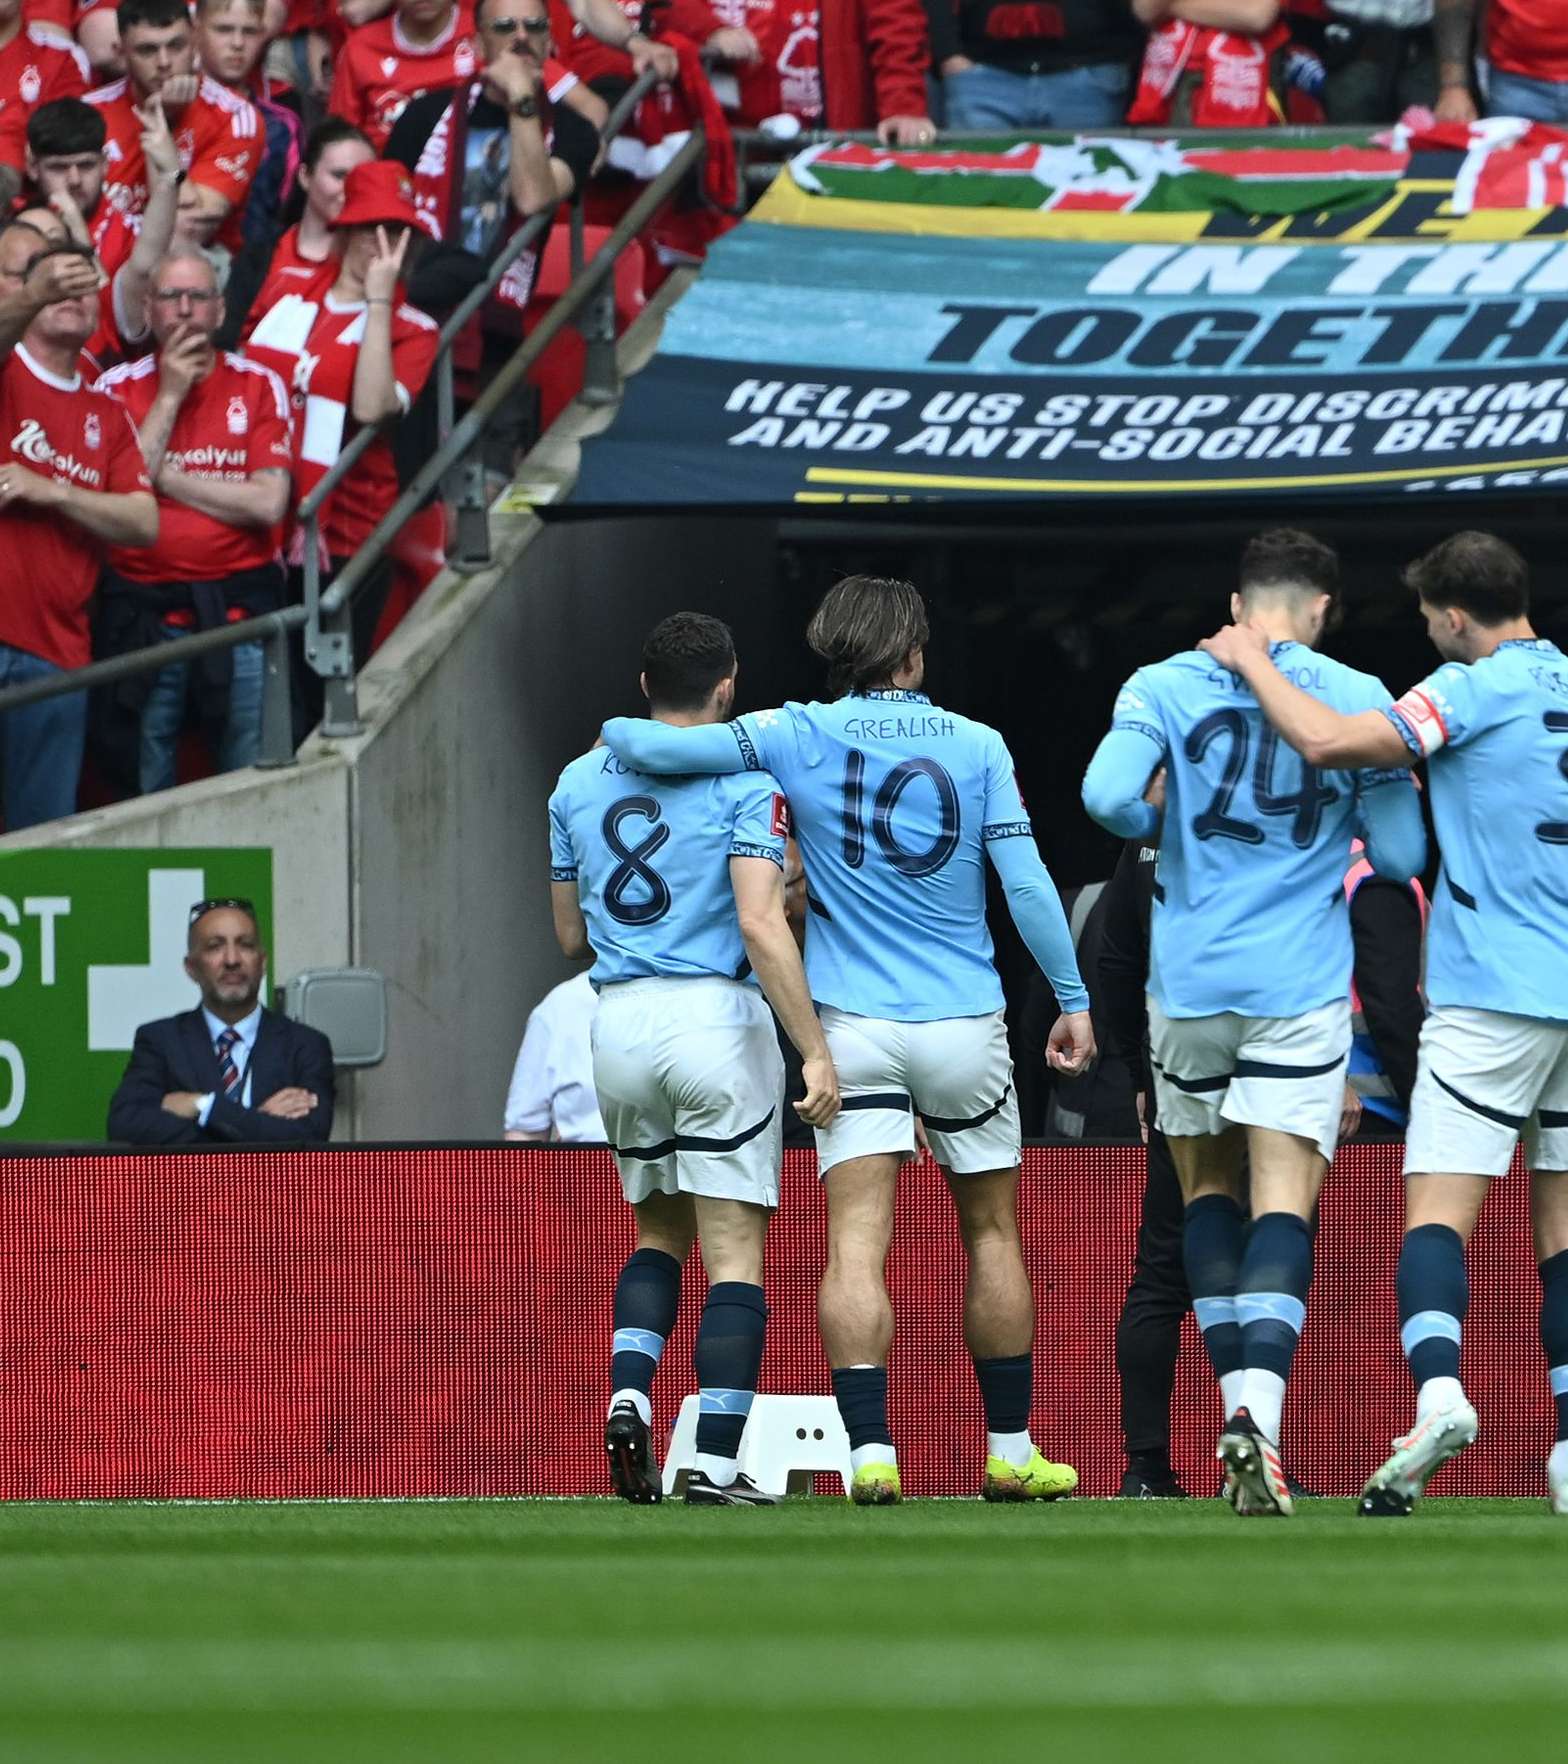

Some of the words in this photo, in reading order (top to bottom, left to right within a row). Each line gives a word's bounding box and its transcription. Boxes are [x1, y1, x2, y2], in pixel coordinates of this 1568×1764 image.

[1085, 244, 1303, 294] IN
[724, 378, 911, 421] HELP
[919, 390, 1025, 426] US
[1034, 393, 1231, 427] STOP
[726, 416, 891, 452] AND
[894, 422, 1356, 462] ANTI-SOCIAL
[844, 717, 956, 740] GREALISH
[1183, 706, 1340, 850] 24
[841, 746, 961, 879] 10
[602, 793, 672, 927] 8
